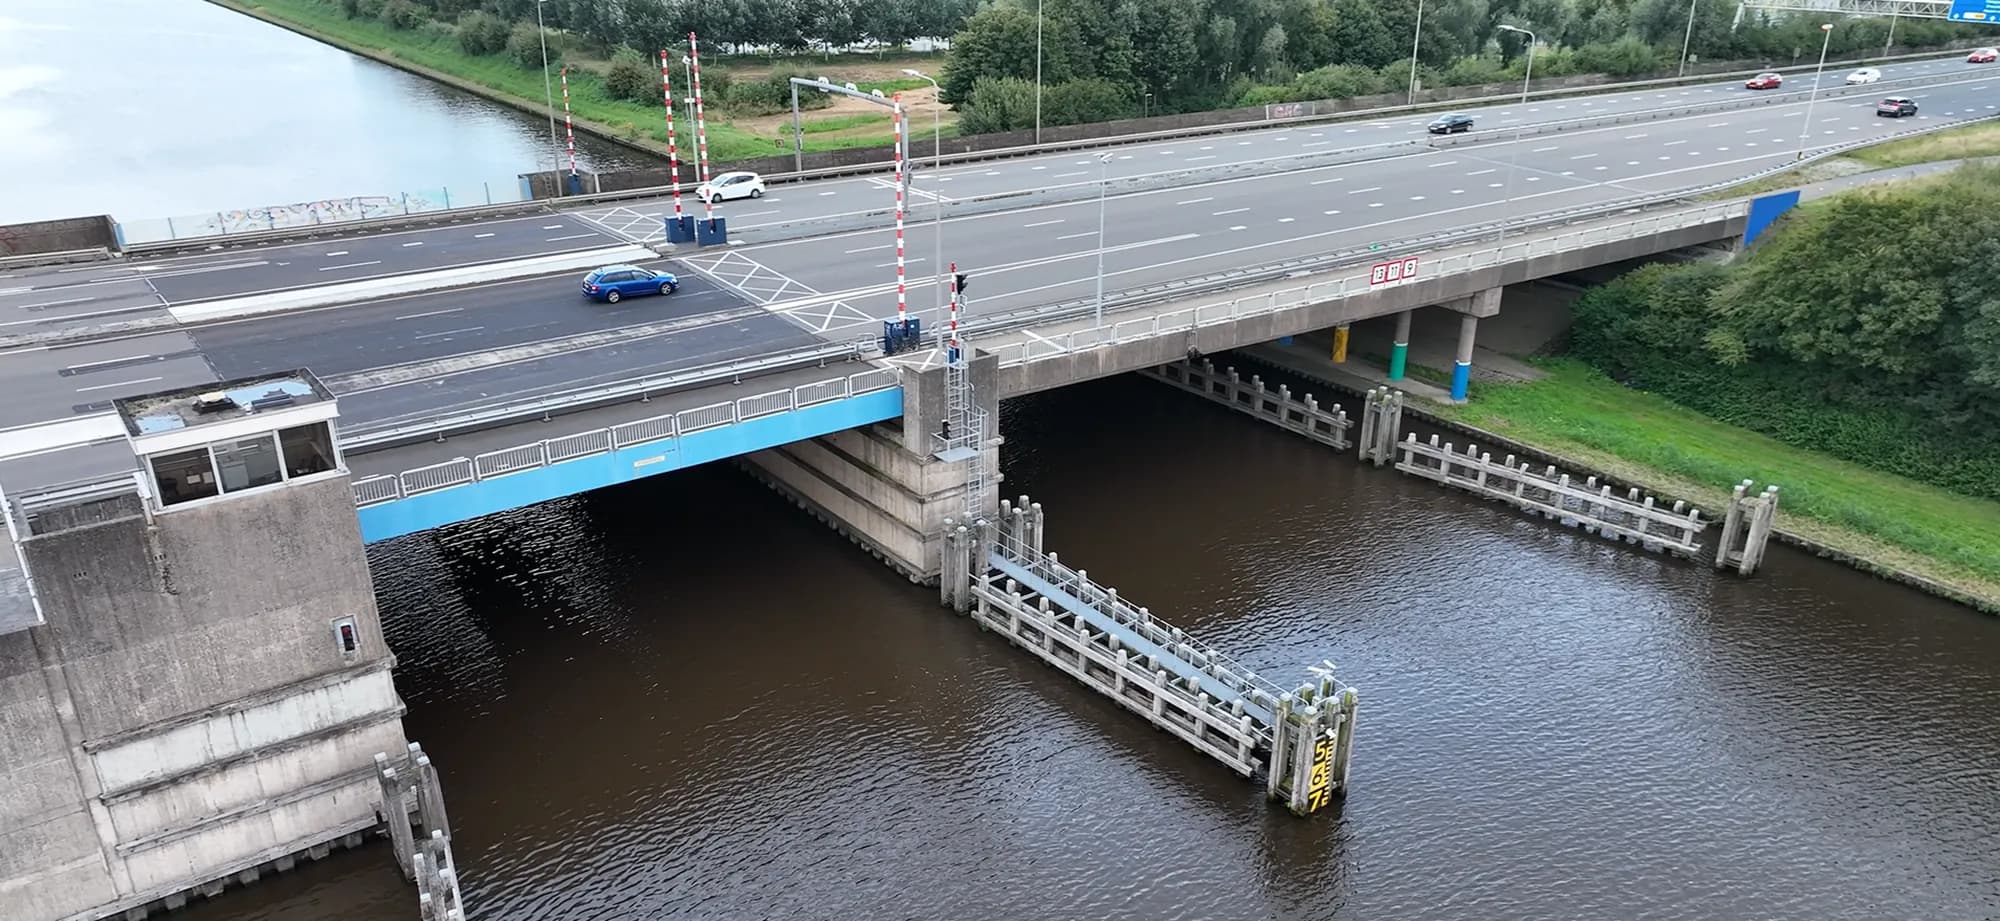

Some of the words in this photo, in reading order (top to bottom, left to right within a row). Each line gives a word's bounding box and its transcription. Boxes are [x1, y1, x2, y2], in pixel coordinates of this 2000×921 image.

[1375, 268, 1384, 280] 13
[1390, 265, 1398, 277] 11
[1407, 263, 1413, 274] 9
[1315, 740, 1326, 761] 5
[1312, 766, 1323, 785] 6
[1308, 789, 1323, 812] 7
